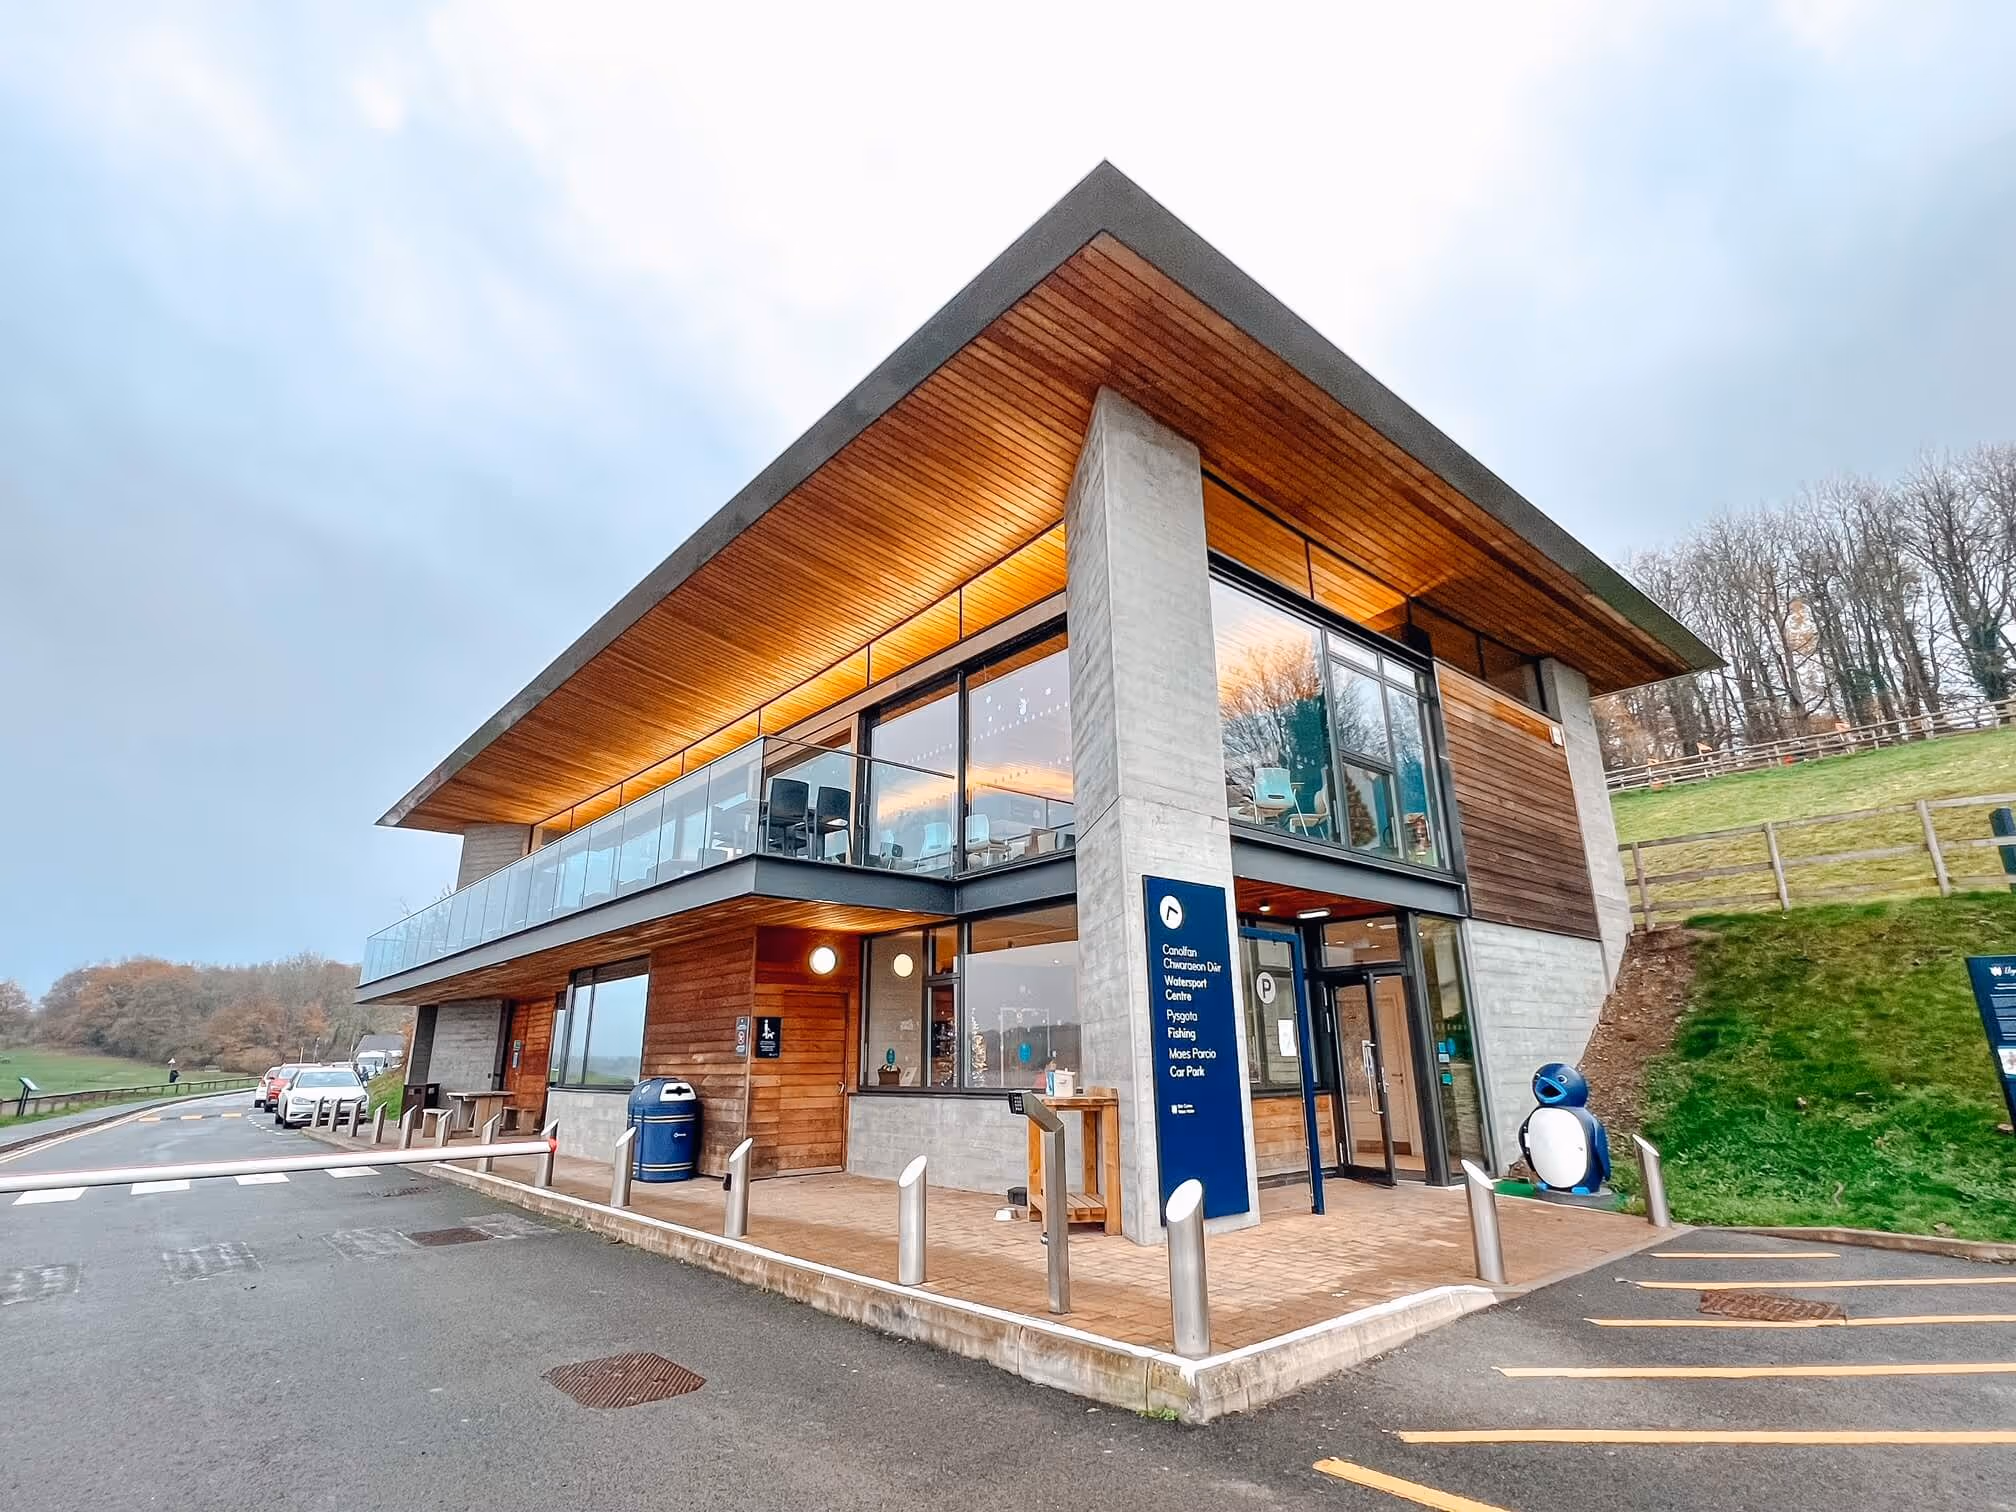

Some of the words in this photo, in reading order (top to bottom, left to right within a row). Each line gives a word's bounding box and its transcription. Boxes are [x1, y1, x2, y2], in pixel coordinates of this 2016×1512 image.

[1162, 944, 1197, 957] Canolfan
[1163, 957, 1206, 972] Chwaraeon
[1164, 975, 1207, 990] Watersport
[1261, 978, 1272, 999] P
[1165, 989, 1192, 1001] Centre
[1166, 1008, 1198, 1024] Pysgota
[1167, 1026, 1196, 1041] Fishing
[1168, 1047, 1191, 1060] Maes
[1192, 1047, 1217, 1060] Parcio
[1169, 1065, 1185, 1078] Car
[1186, 1065, 1205, 1078] Park
